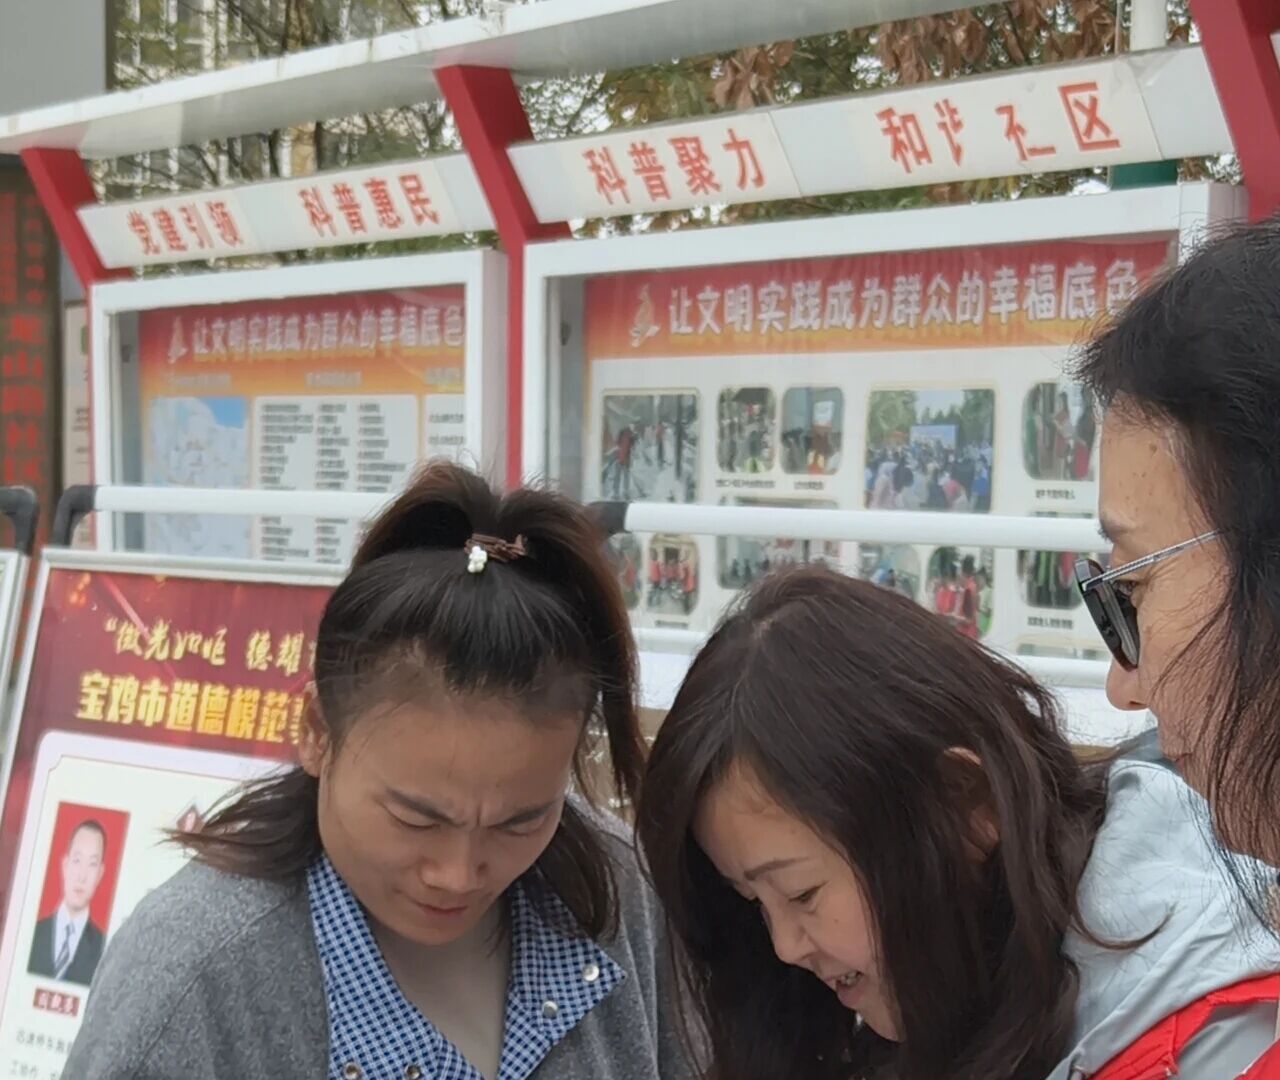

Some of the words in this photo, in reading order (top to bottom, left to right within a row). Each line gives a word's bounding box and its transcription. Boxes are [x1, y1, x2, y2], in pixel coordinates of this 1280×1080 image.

[581, 128, 766, 206] 科普聚力
[126, 199, 244, 256] 党建引领
[298, 173, 441, 237] 科普惠民
[669, 258, 1137, 337] 让文明实践成为群众的幸福底色
[247, 631, 317, 678] 德耀
